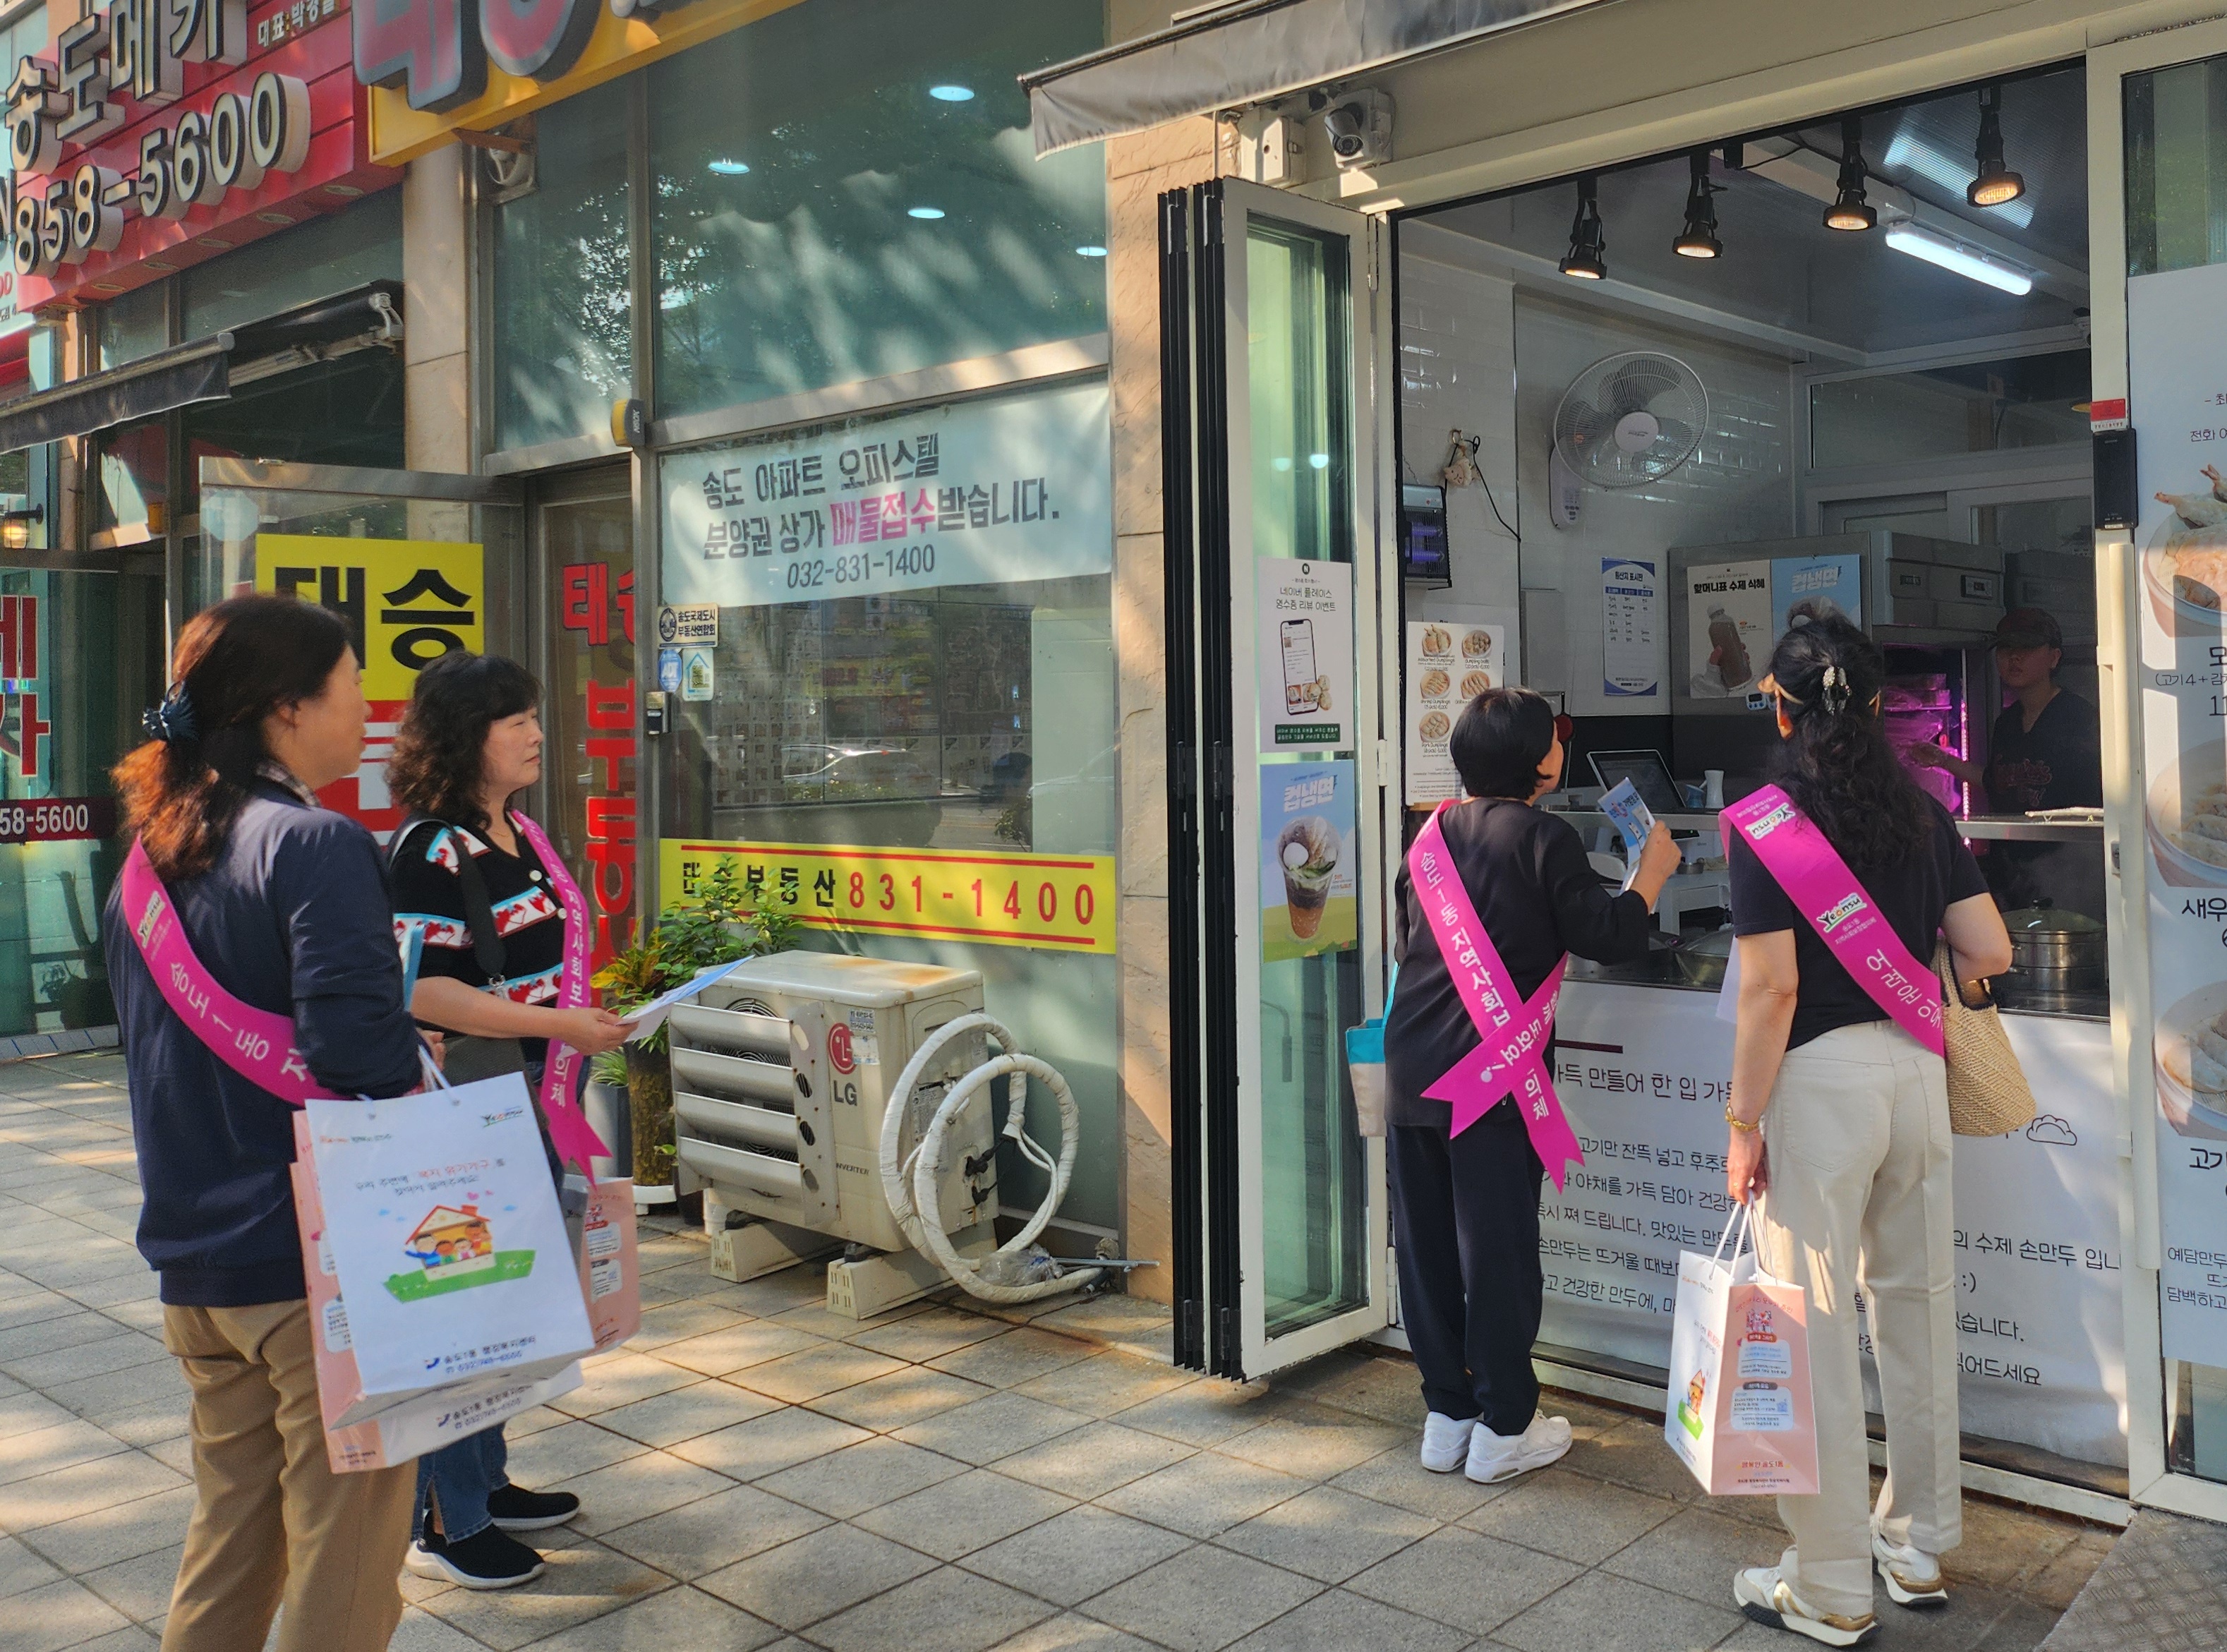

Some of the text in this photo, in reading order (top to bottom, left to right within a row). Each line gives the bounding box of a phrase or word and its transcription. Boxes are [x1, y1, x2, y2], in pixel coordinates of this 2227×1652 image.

[14, 72, 285, 275] 858-5600
[2190, 429, 2215, 442] 전화
[703, 433, 940, 510] 송도 아파트 오피스텔
[704, 518, 773, 560] 분양권
[780, 510, 825, 553] 상가
[787, 543, 935, 589] 032-831-1400
[1280, 587, 1332, 598] 네이버 플레이스
[1694, 578, 1765, 594] 할머니표 수제 식혜
[678, 609, 716, 622] 송도국제도시
[1276, 598, 1336, 613] 영수증 리뷰 이벤트
[1284, 776, 1334, 813] 컵냉면
[850, 872, 1095, 924] 831-1400
[1420, 851, 1459, 926] 송도1동
[1818, 897, 1861, 927] Yeonsu
[169, 961, 270, 1061] 송도1동
[833, 1080, 857, 1107] LG
[1589, 1068, 1644, 1093] 만들어
[1651, 1073, 1672, 1099] 한
[1679, 1077, 1697, 1102] 입
[1579, 1137, 1618, 1158] 고기만
[1622, 1143, 1652, 1164] 잔뜩
[1656, 1148, 1685, 1167] 넣고
[1576, 1172, 1622, 1196] 야채를
[1626, 1181, 1656, 1201] 가득
[1661, 1185, 1694, 1206] 담아
[1564, 1207, 1579, 1223] 쪄
[1584, 1210, 1646, 1236] 드립니다.
[1651, 1221, 1696, 1246] 맛있는
[1596, 1248, 1639, 1271] 뜨거울
[1975, 1232, 2012, 1255] 수제
[2020, 1238, 2077, 1267] 손만두
[1543, 1272, 1559, 1292] 고
[1563, 1277, 1605, 1301] 건강한
[1609, 1286, 1658, 1314] 만두에,
[2167, 1286, 2227, 1310] 담백하고
[1955, 1312, 2024, 1342] 습니다.
